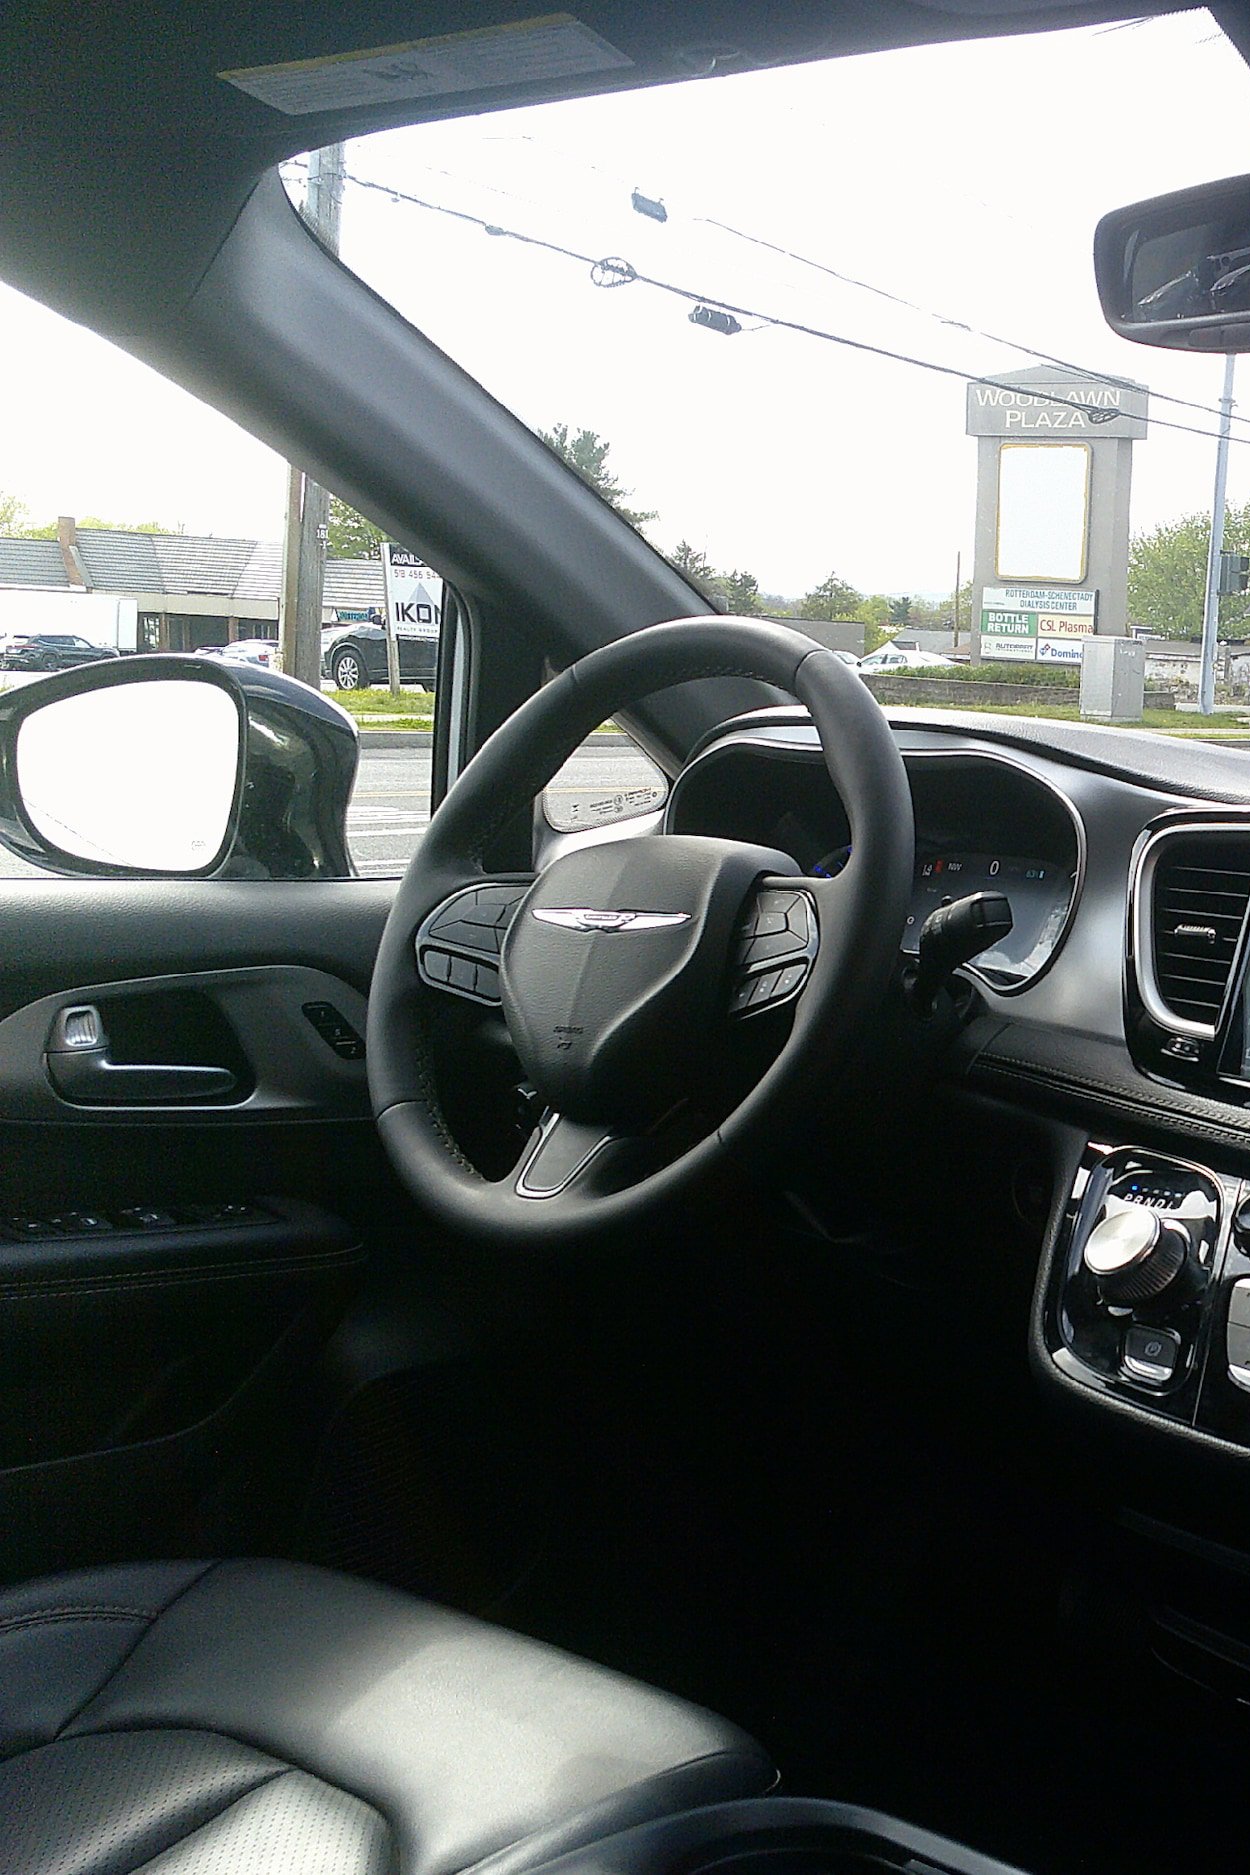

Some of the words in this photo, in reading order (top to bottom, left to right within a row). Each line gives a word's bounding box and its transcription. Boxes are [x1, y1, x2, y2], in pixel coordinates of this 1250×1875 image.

[976, 389, 1121, 406] WOODLAWN
[1005, 410, 1086, 428] PLAZA
[1020, 600, 1051, 610] DIALYSIS
[1051, 601, 1077, 611] CENTER
[988, 612, 1029, 623] BOTTLE
[987, 623, 1029, 634] RETURN
[1040, 619, 1057, 632] CSL
[1058, 620, 1094, 634] Plasma
